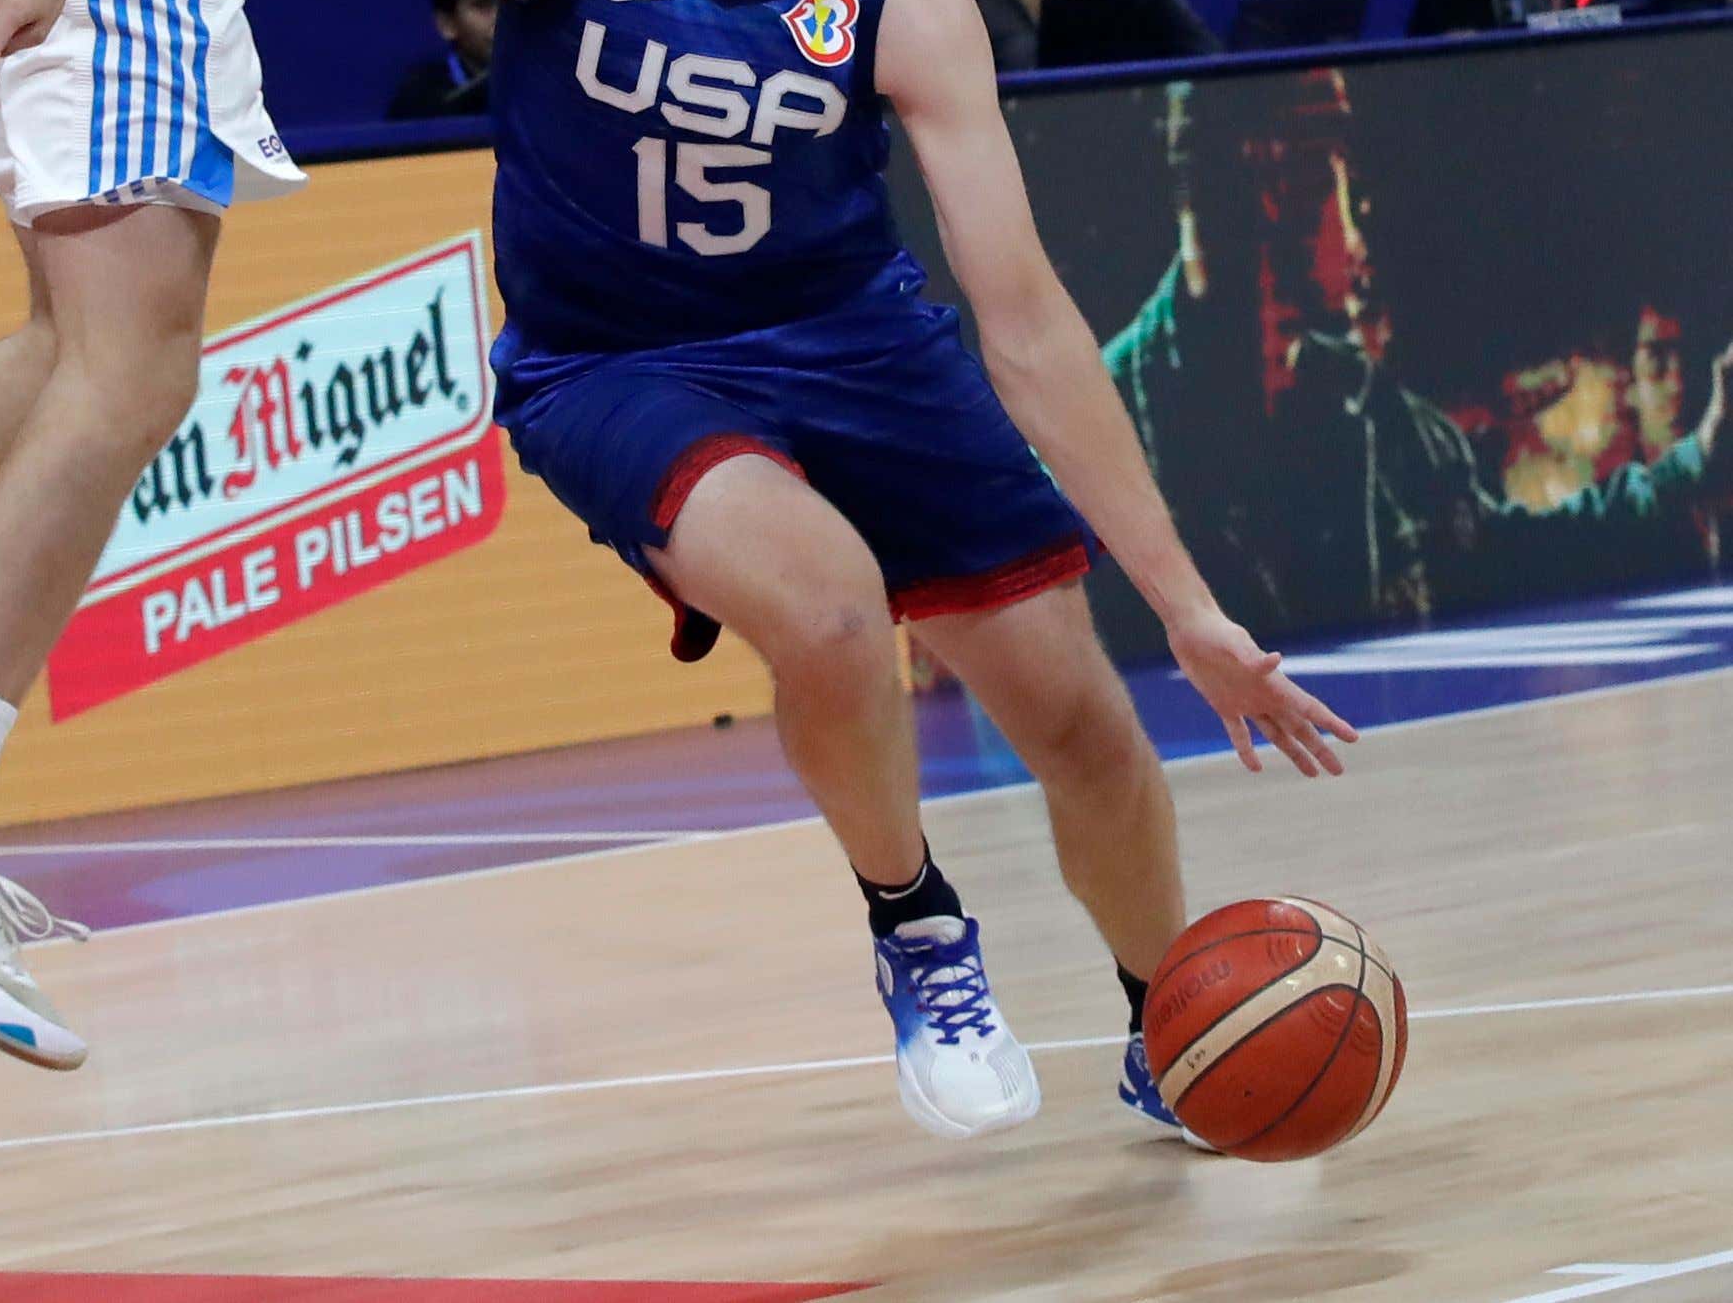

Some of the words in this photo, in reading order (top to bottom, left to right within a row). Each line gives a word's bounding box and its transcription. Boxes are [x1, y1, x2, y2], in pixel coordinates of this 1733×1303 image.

[575, 19, 848, 146] USA
[632, 136, 772, 256] 15
[222, 285, 456, 498] Miguel
[141, 547, 282, 655] PALE
[293, 462, 483, 590] PILSEN
